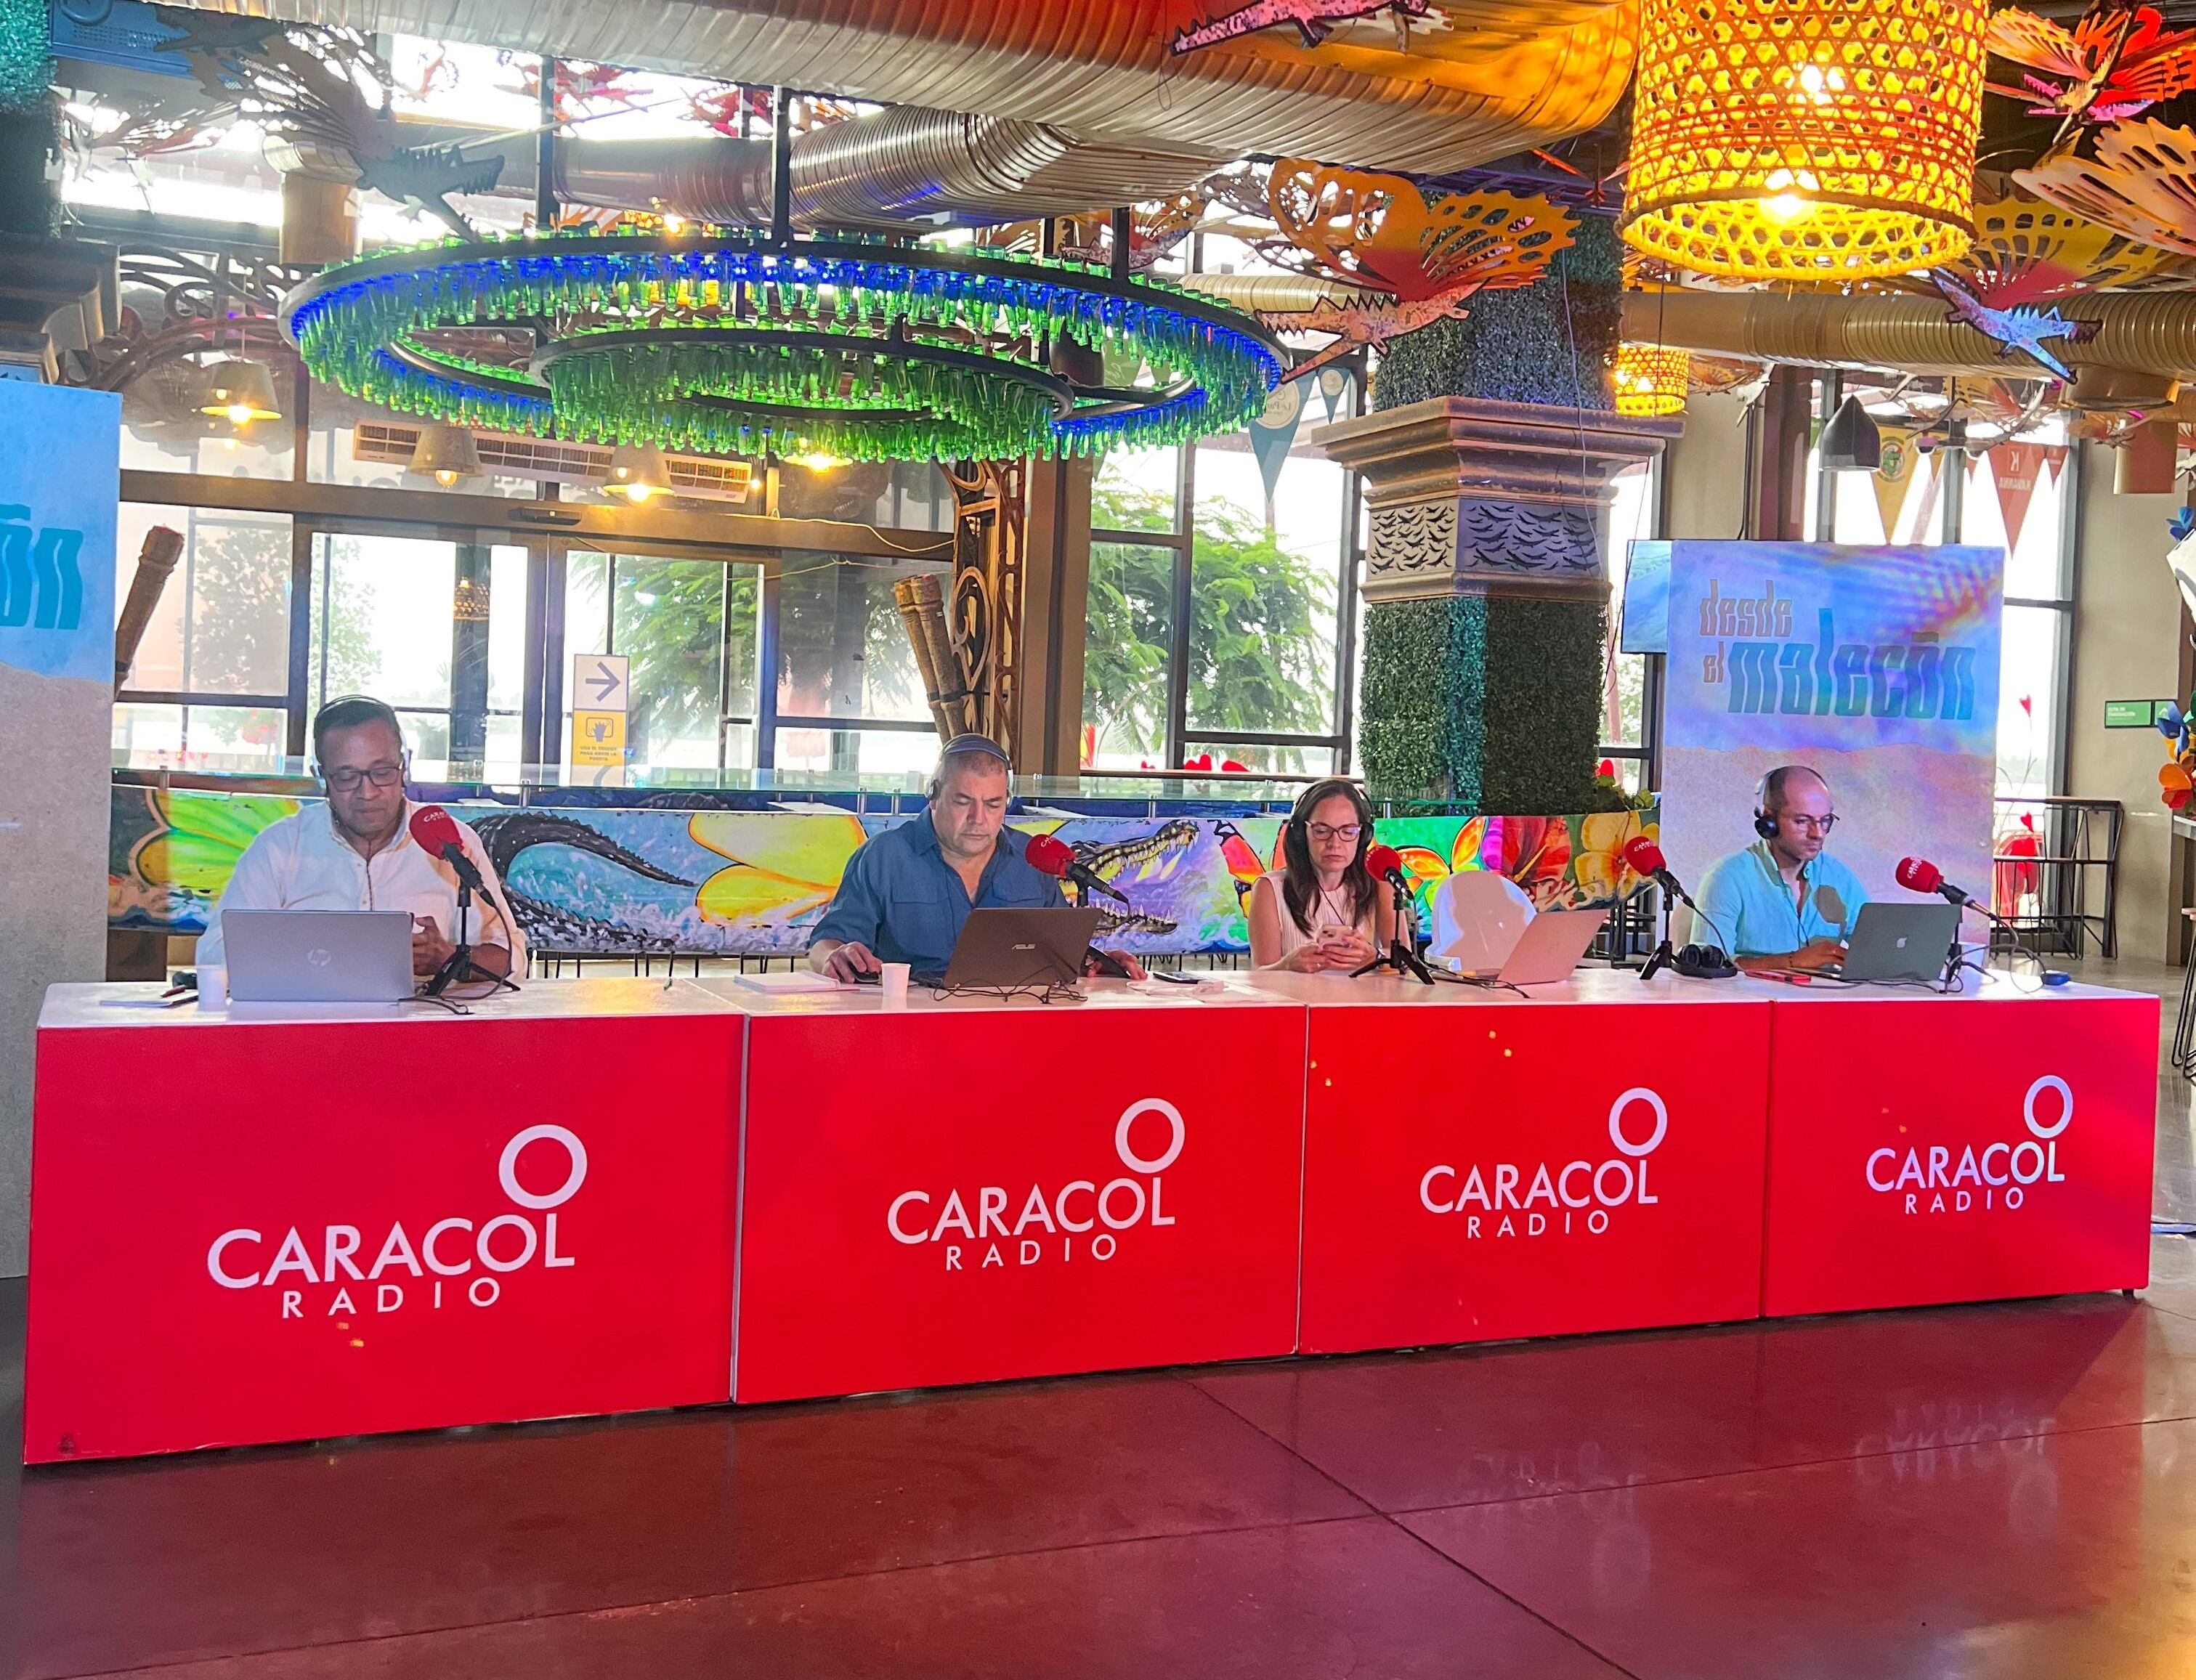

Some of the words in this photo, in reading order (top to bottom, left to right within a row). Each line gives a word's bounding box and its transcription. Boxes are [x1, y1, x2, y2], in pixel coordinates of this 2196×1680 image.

[1699, 579, 1792, 637] desde
[1703, 641, 1725, 683] el
[1727, 608, 1976, 720] malecón
[1419, 1159, 1658, 1214] CARACOL
[1865, 1140, 2065, 1192] CARACOL
[887, 1177, 1175, 1245] CARACOL
[1467, 1209, 1609, 1239] RADIO
[1905, 1186, 2024, 1214] RADIO
[207, 1212, 575, 1289] CARACOL
[946, 1233, 1117, 1271] RADIO
[282, 1276, 501, 1319] RADIO
